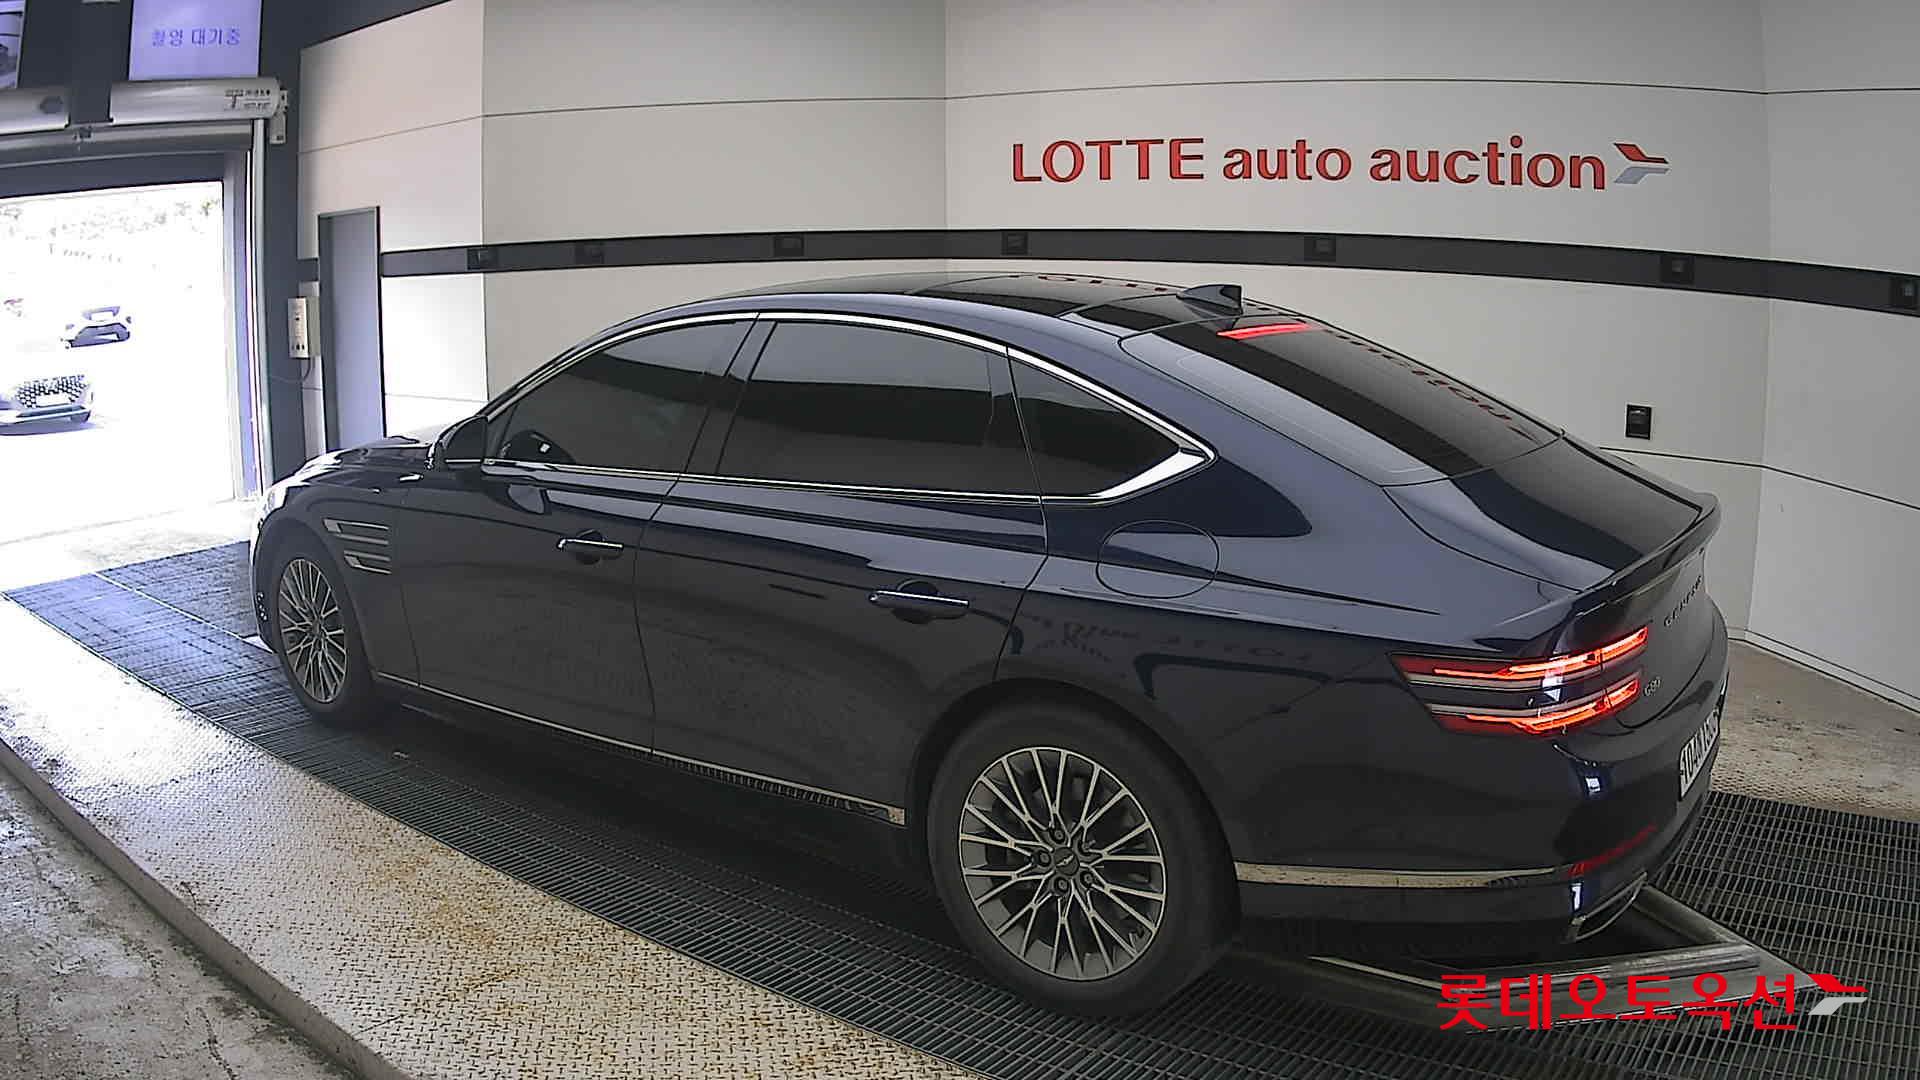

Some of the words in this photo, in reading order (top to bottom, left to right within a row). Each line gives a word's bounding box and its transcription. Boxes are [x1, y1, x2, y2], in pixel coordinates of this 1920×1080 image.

[192, 27, 241, 46] 대기중
[1012, 138, 1205, 183] LOTTE
[1223, 139, 1353, 182] auto
[1370, 135, 1606, 190] auction
